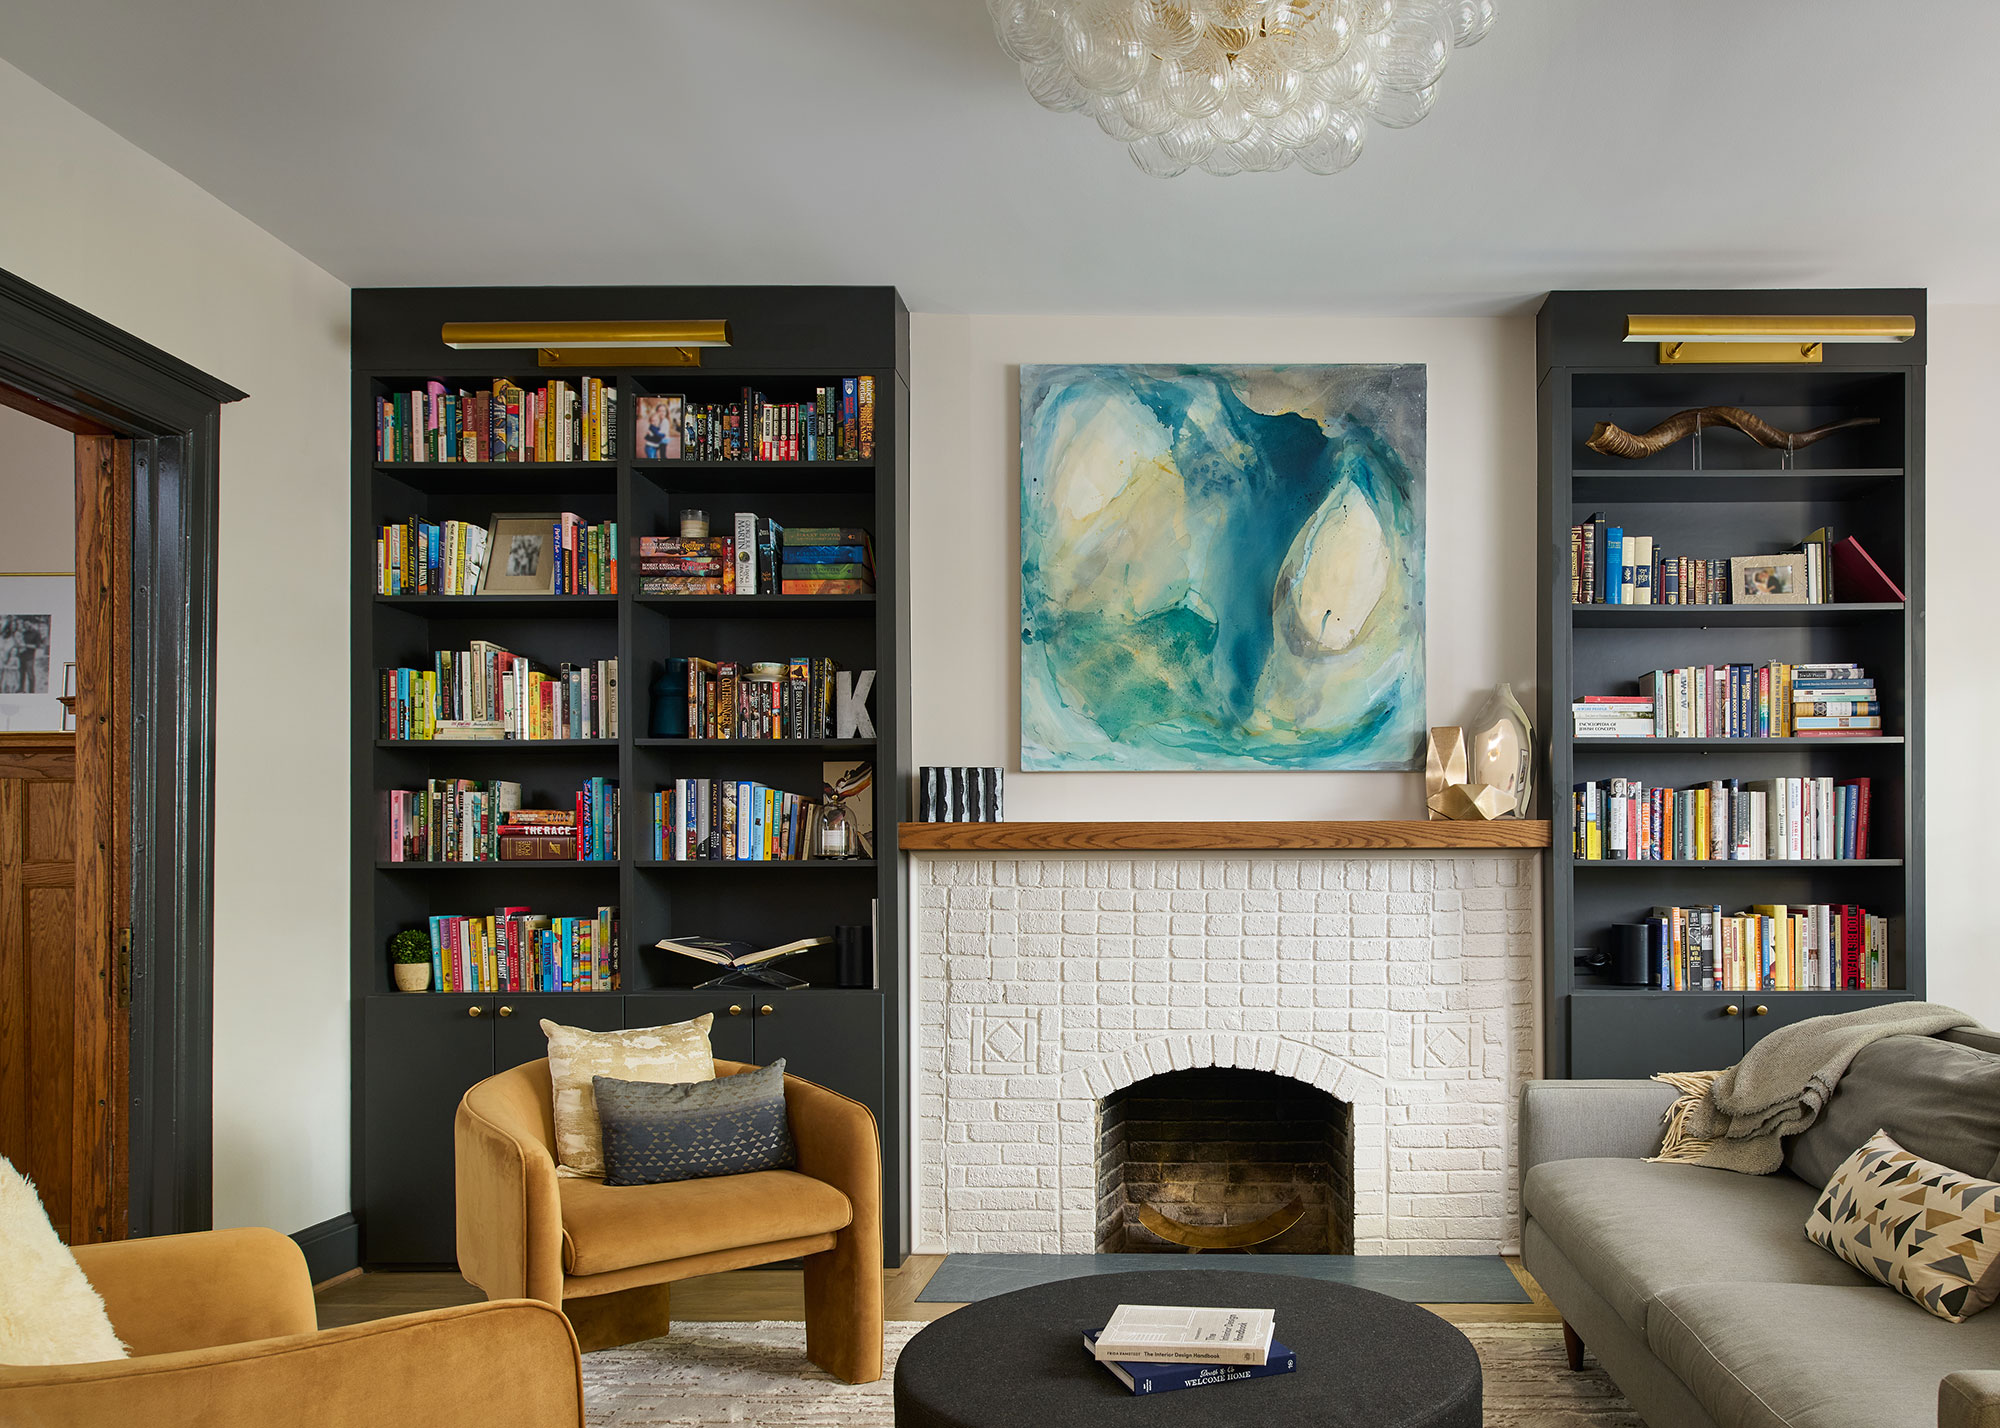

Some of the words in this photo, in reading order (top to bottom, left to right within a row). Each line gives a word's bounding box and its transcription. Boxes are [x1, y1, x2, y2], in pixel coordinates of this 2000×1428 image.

[721, 678, 732, 726] OATHBRINGER
[836, 670, 877, 739] K
[523, 826, 543, 836] THE
[544, 826, 571, 836] RACE
[496, 915, 505, 925] THE
[1847, 916, 1857, 932] TOO
[496, 928, 505, 946] LONELY
[1847, 933, 1857, 948] BIG
[1847, 950, 1857, 961] TO
[497, 949, 507, 979] POLYGAMIST
[1847, 962, 1857, 978] FAIL
[1184, 1374, 1226, 1387] WELCOME
[1227, 1370, 1251, 1381] HOME
